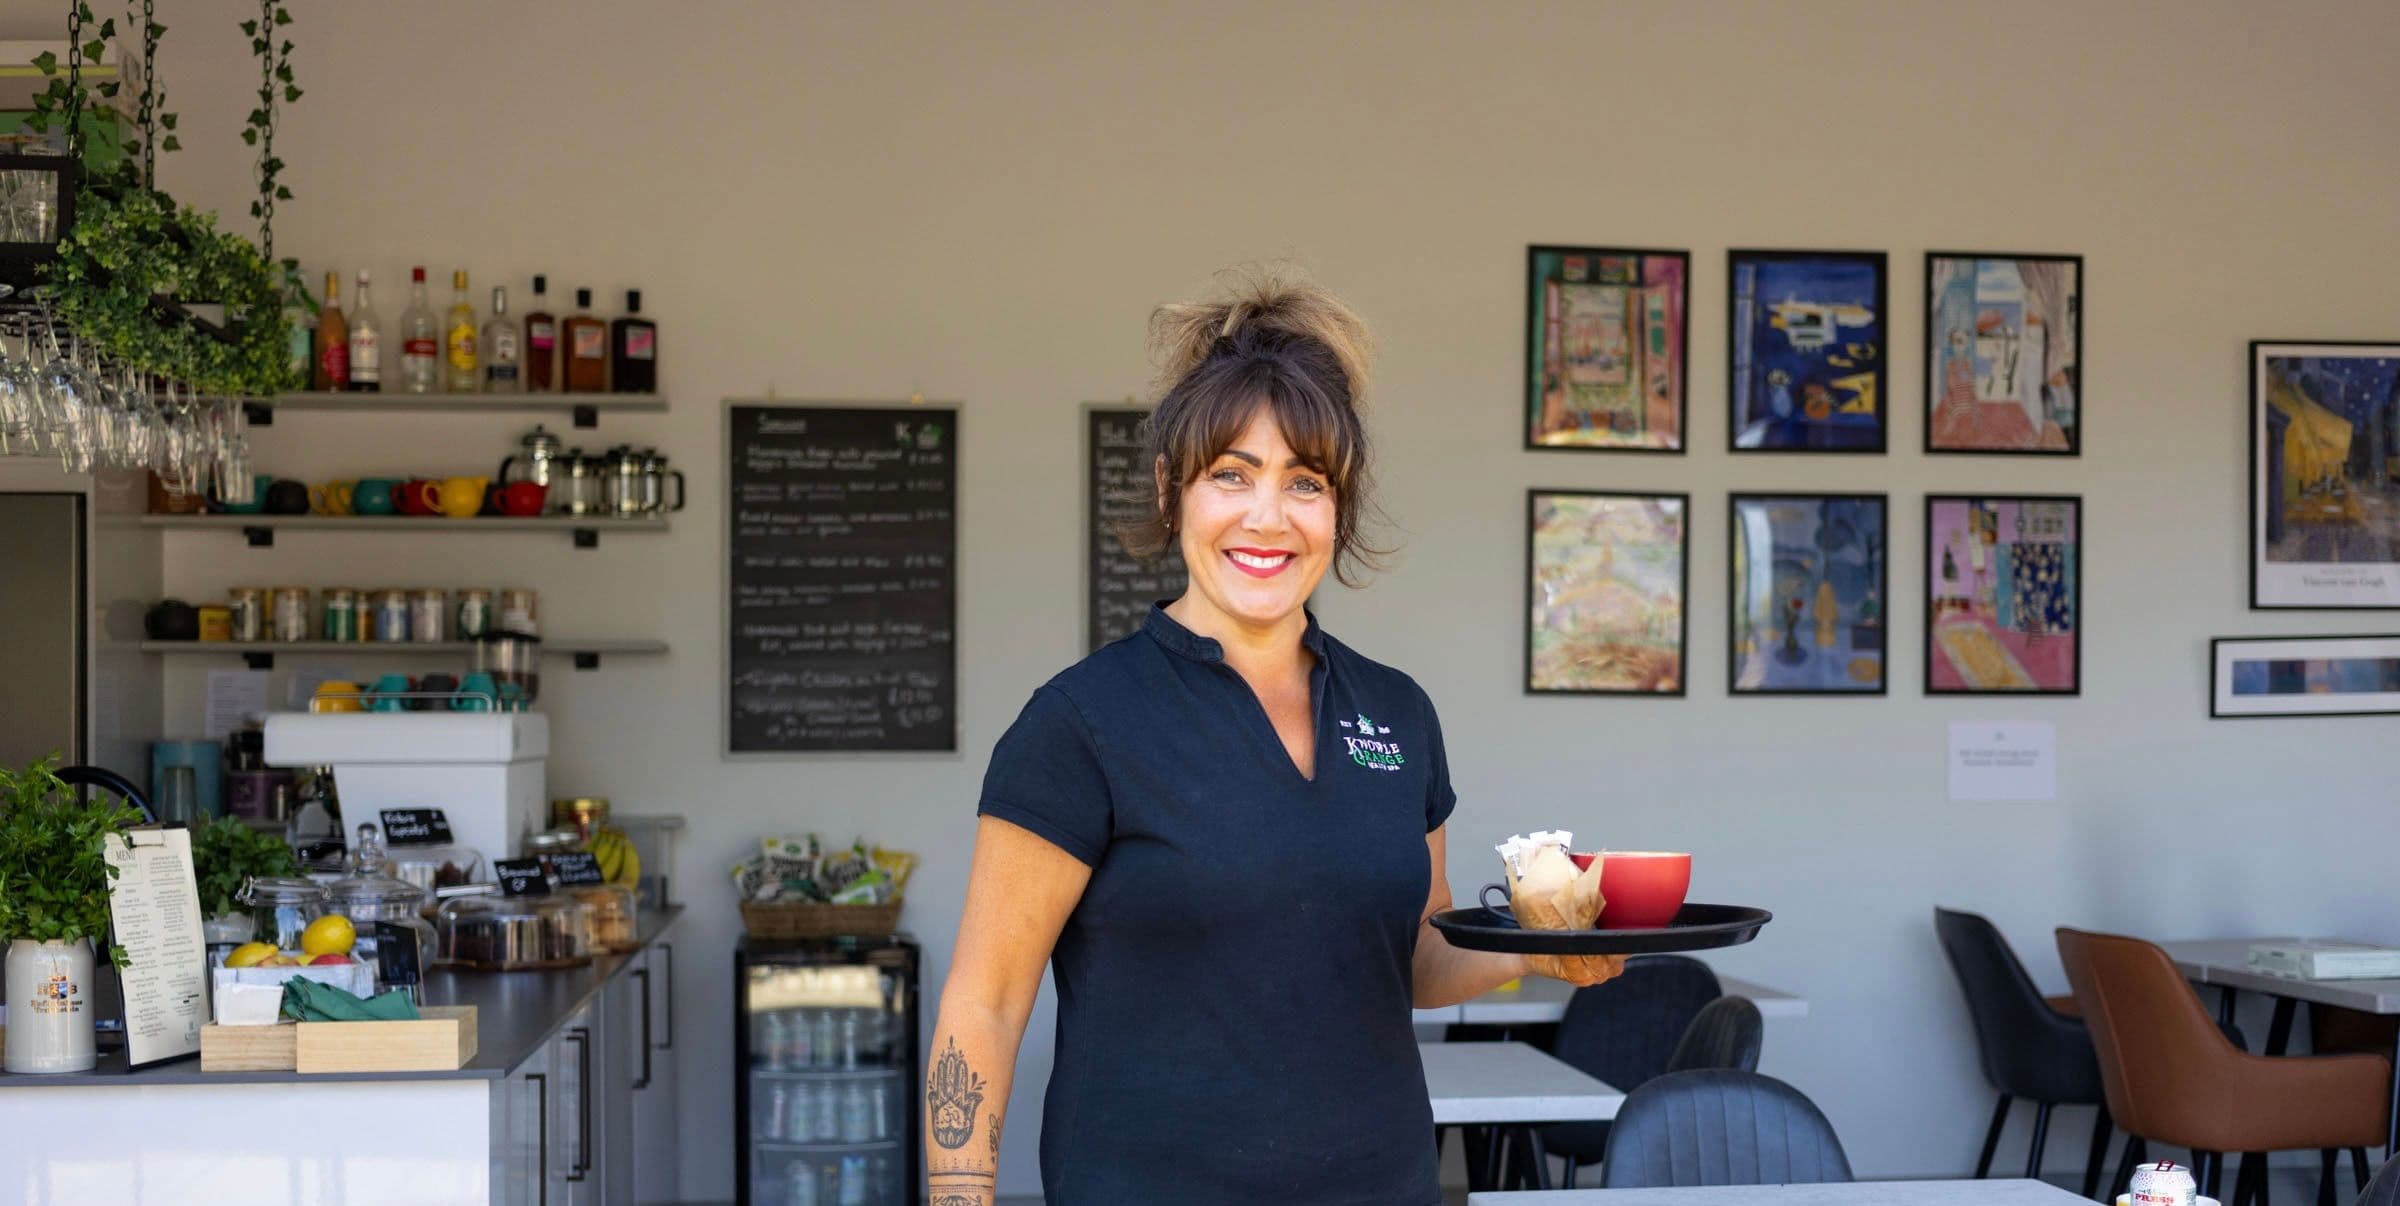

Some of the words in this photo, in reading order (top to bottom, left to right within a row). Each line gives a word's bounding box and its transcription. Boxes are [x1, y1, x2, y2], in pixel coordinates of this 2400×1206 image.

[1343, 736, 1400, 758] KNOWLE
[1353, 750, 1405, 766] GRANGE
[115, 849, 136, 861] MENU
